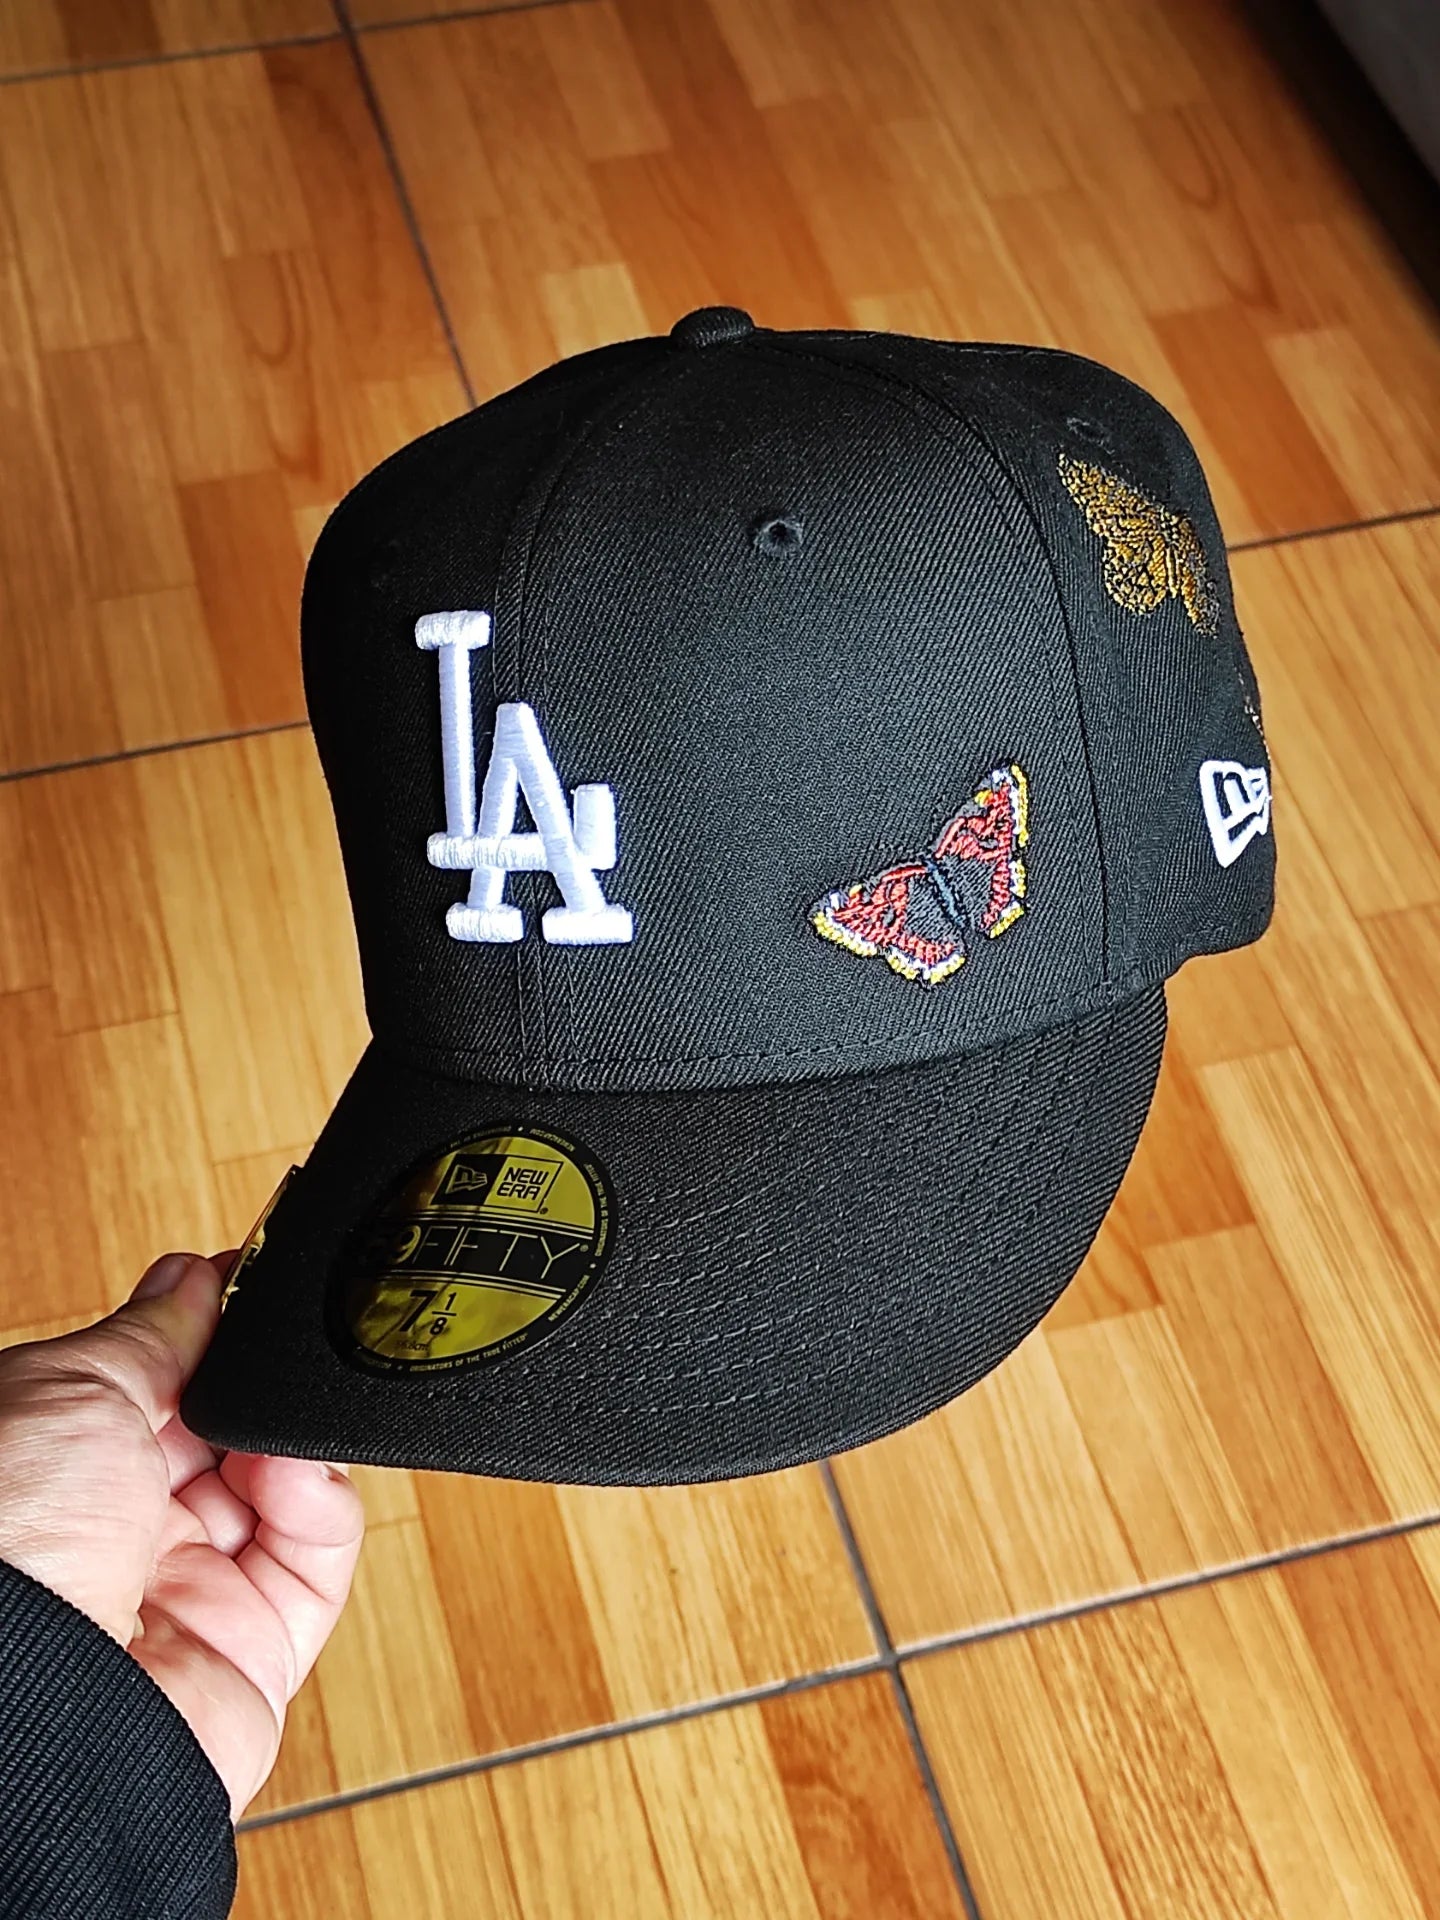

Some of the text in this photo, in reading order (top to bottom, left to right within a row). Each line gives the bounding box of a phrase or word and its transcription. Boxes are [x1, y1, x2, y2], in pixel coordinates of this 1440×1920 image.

[414, 610, 634, 946] LA
[496, 1181, 542, 1201] ERA
[507, 1166, 550, 1186] NEW
[399, 1289, 440, 1333] 7
